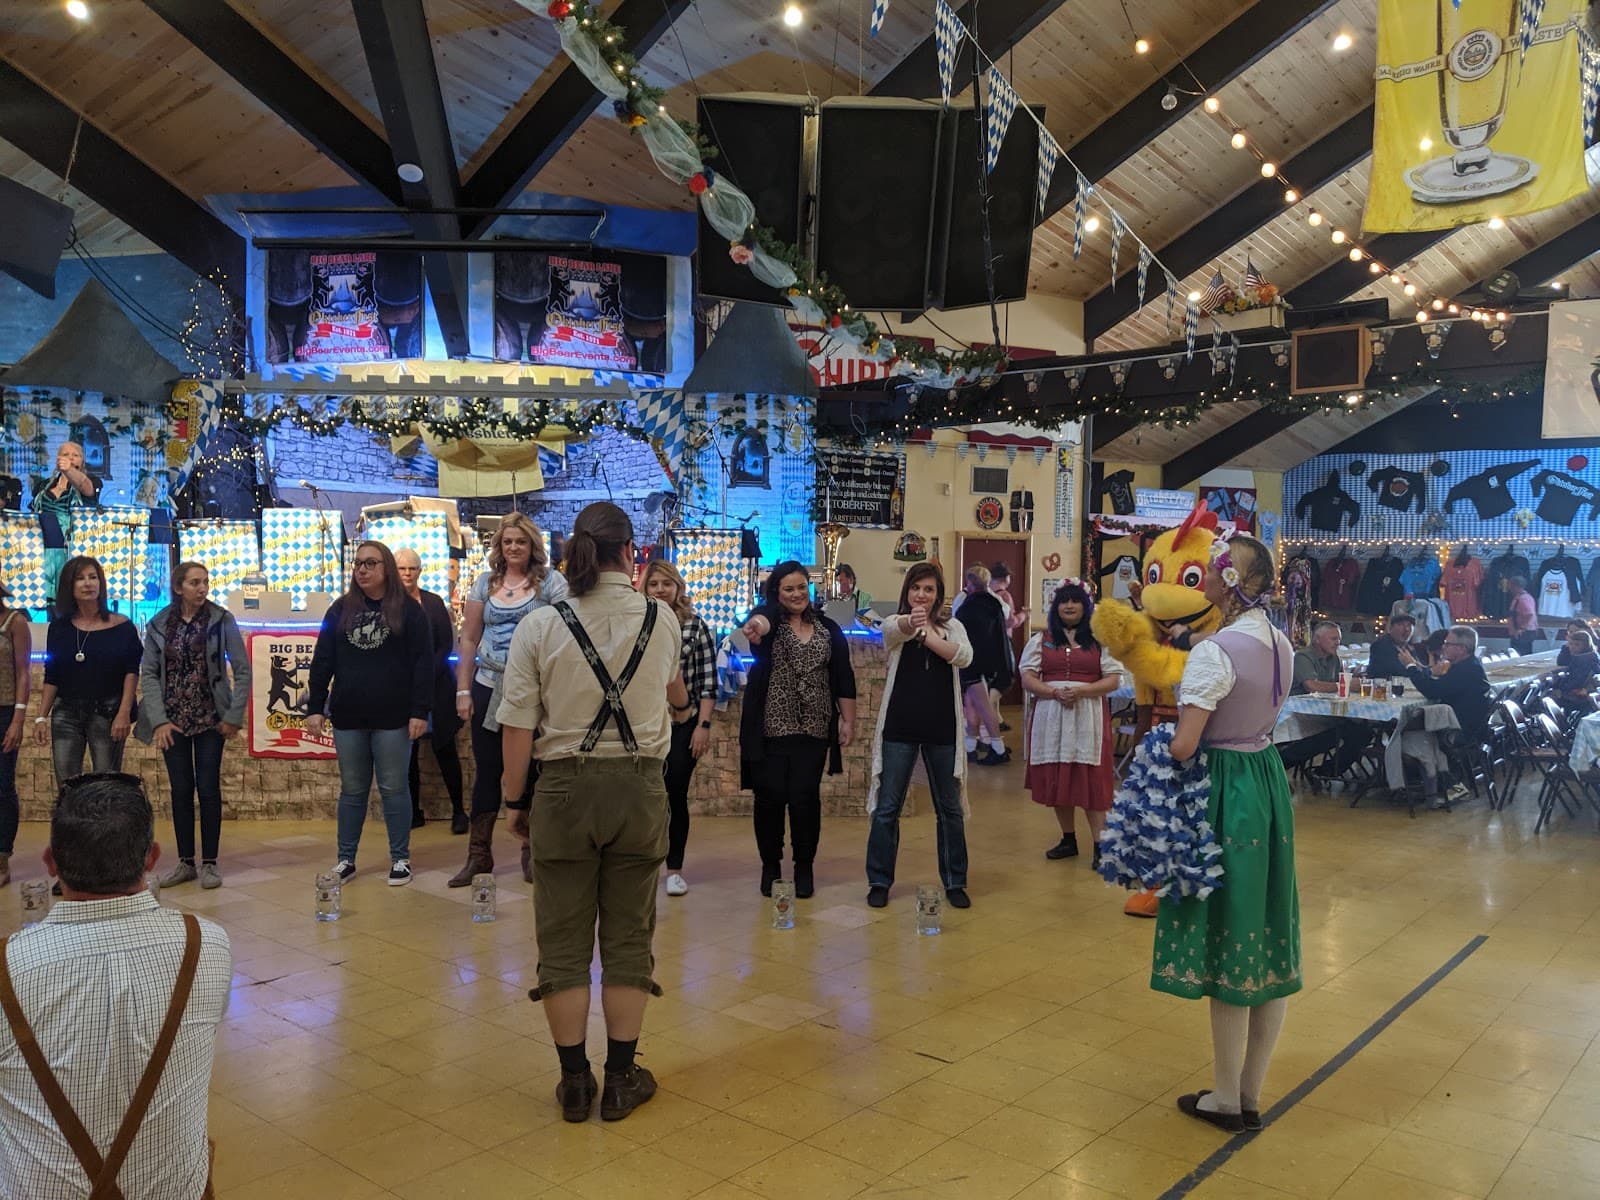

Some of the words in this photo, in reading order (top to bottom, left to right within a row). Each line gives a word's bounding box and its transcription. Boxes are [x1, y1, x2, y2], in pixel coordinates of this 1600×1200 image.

[818, 499, 881, 512] OTOBERFEST
[832, 514, 872, 523] ARSTEINER
[269, 644, 292, 654] BIG
[296, 644, 313, 654] BE
[302, 733, 316, 742] Est.
[319, 737, 335, 747] 197
